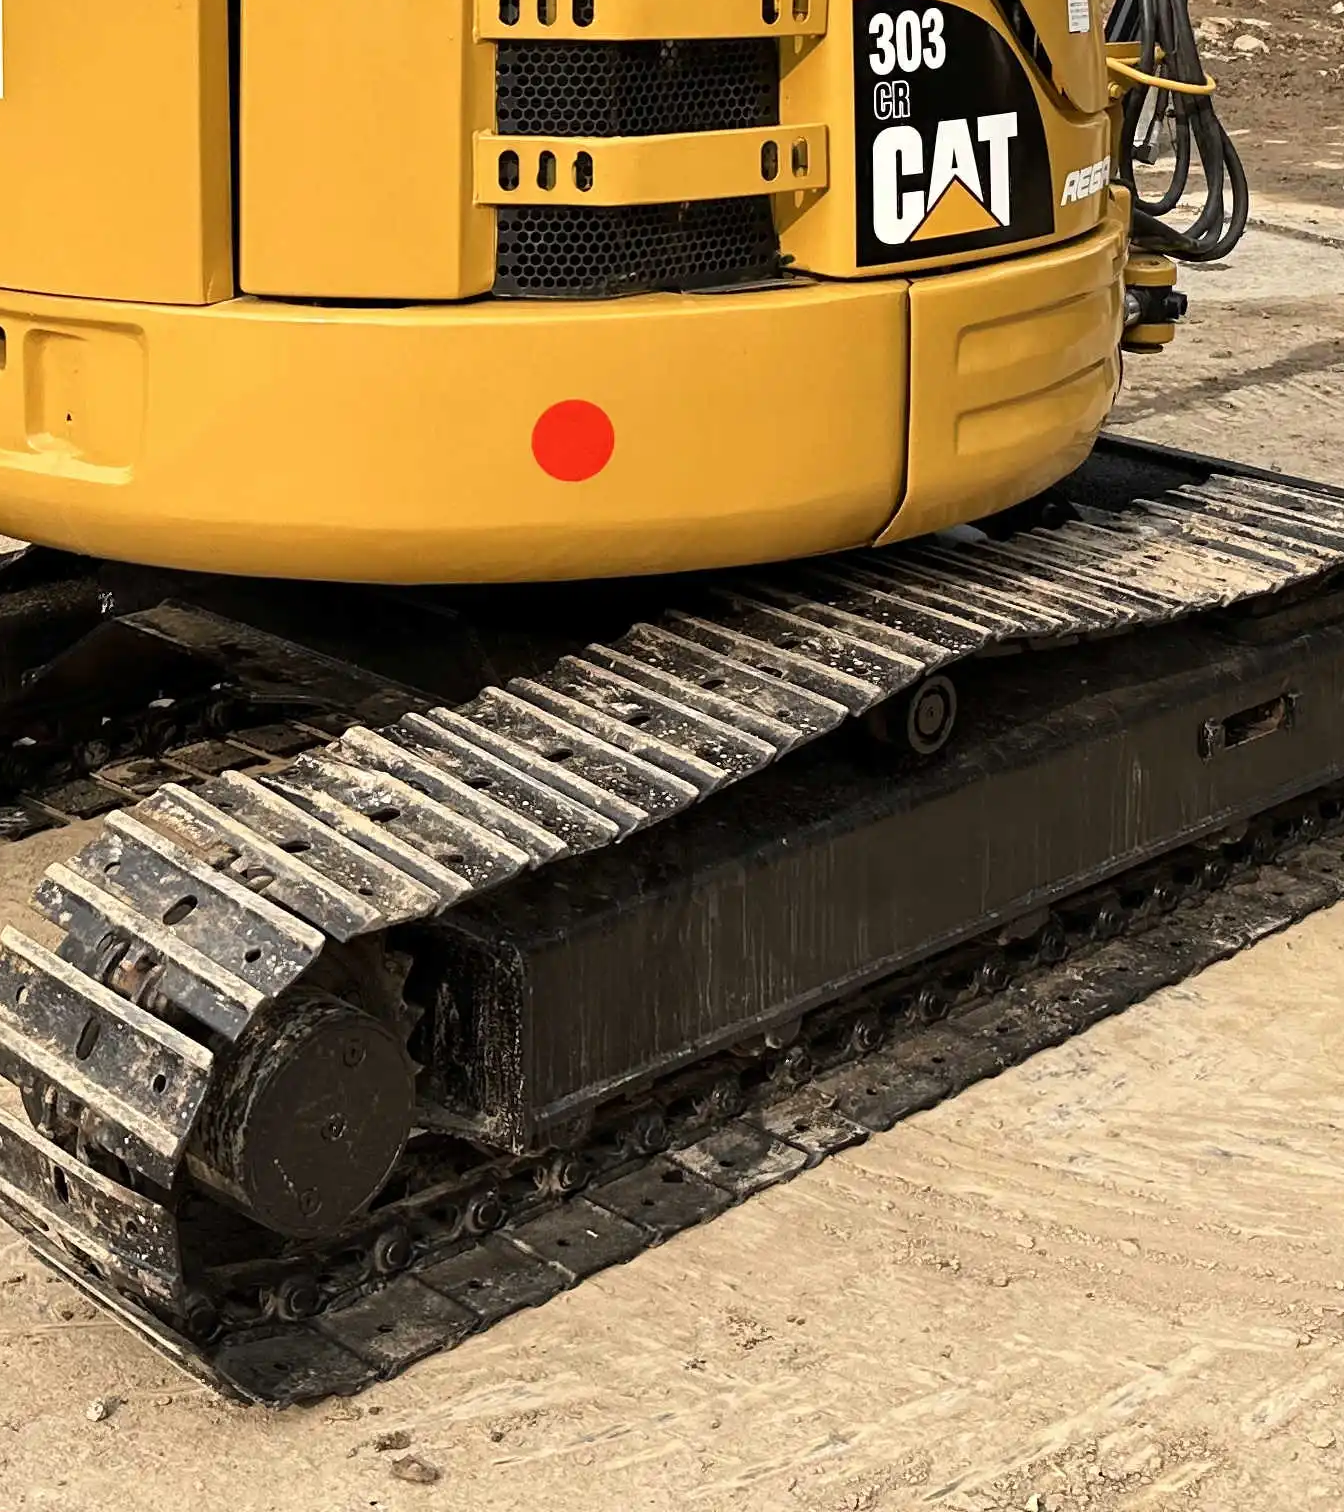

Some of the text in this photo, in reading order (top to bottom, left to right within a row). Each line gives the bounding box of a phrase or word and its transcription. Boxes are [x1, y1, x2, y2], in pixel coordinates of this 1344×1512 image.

[868, 7, 947, 76] 303
[873, 79, 911, 121] CR
[872, 111, 1018, 245] CAT
